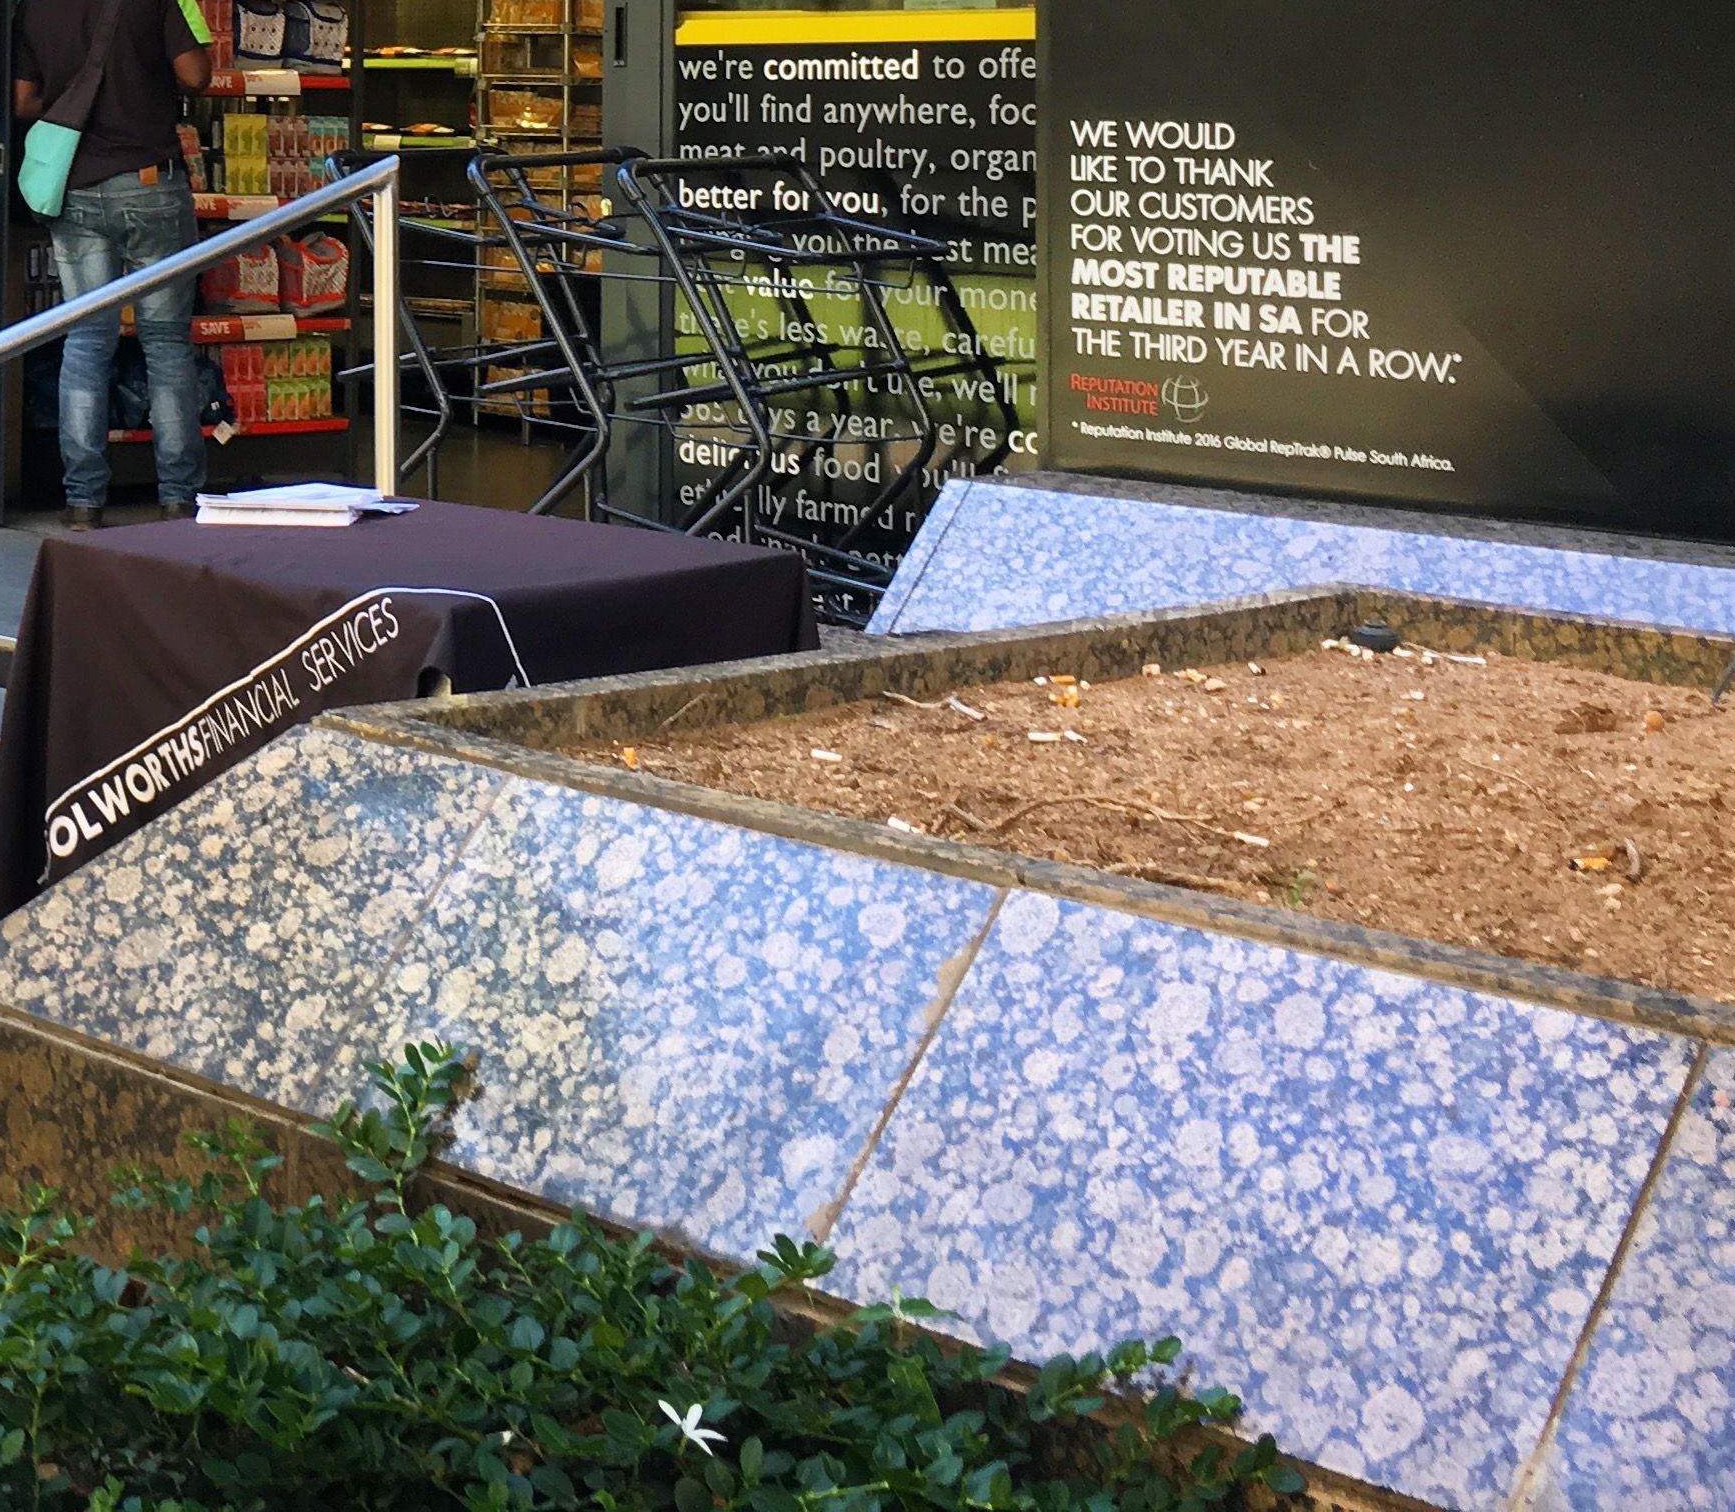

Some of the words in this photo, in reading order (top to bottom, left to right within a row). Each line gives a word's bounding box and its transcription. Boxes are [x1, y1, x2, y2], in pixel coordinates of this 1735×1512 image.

[210, 75, 233, 88] AVE
[678, 49, 754, 81] we're
[763, 48, 920, 81] committed
[932, 54, 965, 80] to
[978, 47, 1037, 80] offe
[678, 92, 749, 131] you'll
[760, 92, 812, 123] find
[823, 93, 976, 133] anywhere,
[1070, 119, 1118, 148] WE
[1125, 120, 1236, 150] WOULD
[820, 137, 936, 179] poultry,
[950, 148, 1037, 181] organ
[1070, 154, 1118, 182] LIKE
[1125, 156, 1165, 184] TO
[1173, 157, 1275, 188] THANK
[195, 196, 217, 211] AVE
[678, 178, 763, 210] better
[772, 180, 811, 212] for
[899, 183, 946, 216] for
[957, 185, 1009, 218] the
[1070, 188, 1131, 218] OUR
[1138, 191, 1315, 226] CUSTOMERS
[1071, 223, 1123, 253] FOR
[1130, 225, 1244, 259] VOTING
[1252, 231, 1291, 261] US
[1299, 233, 1360, 264] THE
[743, 267, 814, 300] value
[1071, 257, 1160, 290] MOST
[1167, 262, 1341, 301] REPUTABLE
[200, 321, 230, 336] SAVE
[1071, 292, 1206, 328] RETAILER
[1214, 300, 1251, 332] IN
[1258, 303, 1303, 335] SA
[1311, 307, 1370, 340] FOR
[780, 311, 829, 344] less
[941, 326, 1035, 360] carefu
[1071, 327, 1122, 358] THE
[1129, 331, 1208, 364] THIRD
[1215, 337, 1287, 371] YEAR
[1295, 342, 1328, 375] IN
[1336, 345, 1362, 377] A
[951, 370, 1017, 405] we'll
[806, 410, 821, 433] a
[813, 446, 880, 484] food
[1080, 421, 1144, 441] Reputation
[1145, 427, 1192, 445] Institute
[1194, 432, 1222, 449] 2016
[1224, 435, 1268, 453] Global
[1334, 445, 1367, 463] Pulse
[1369, 449, 1408, 467] South
[1411, 453, 1455, 472] Africa.
[48, 668, 300, 858] OLWORTHSFINANCIAL
[301, 596, 399, 692] SERVICES
